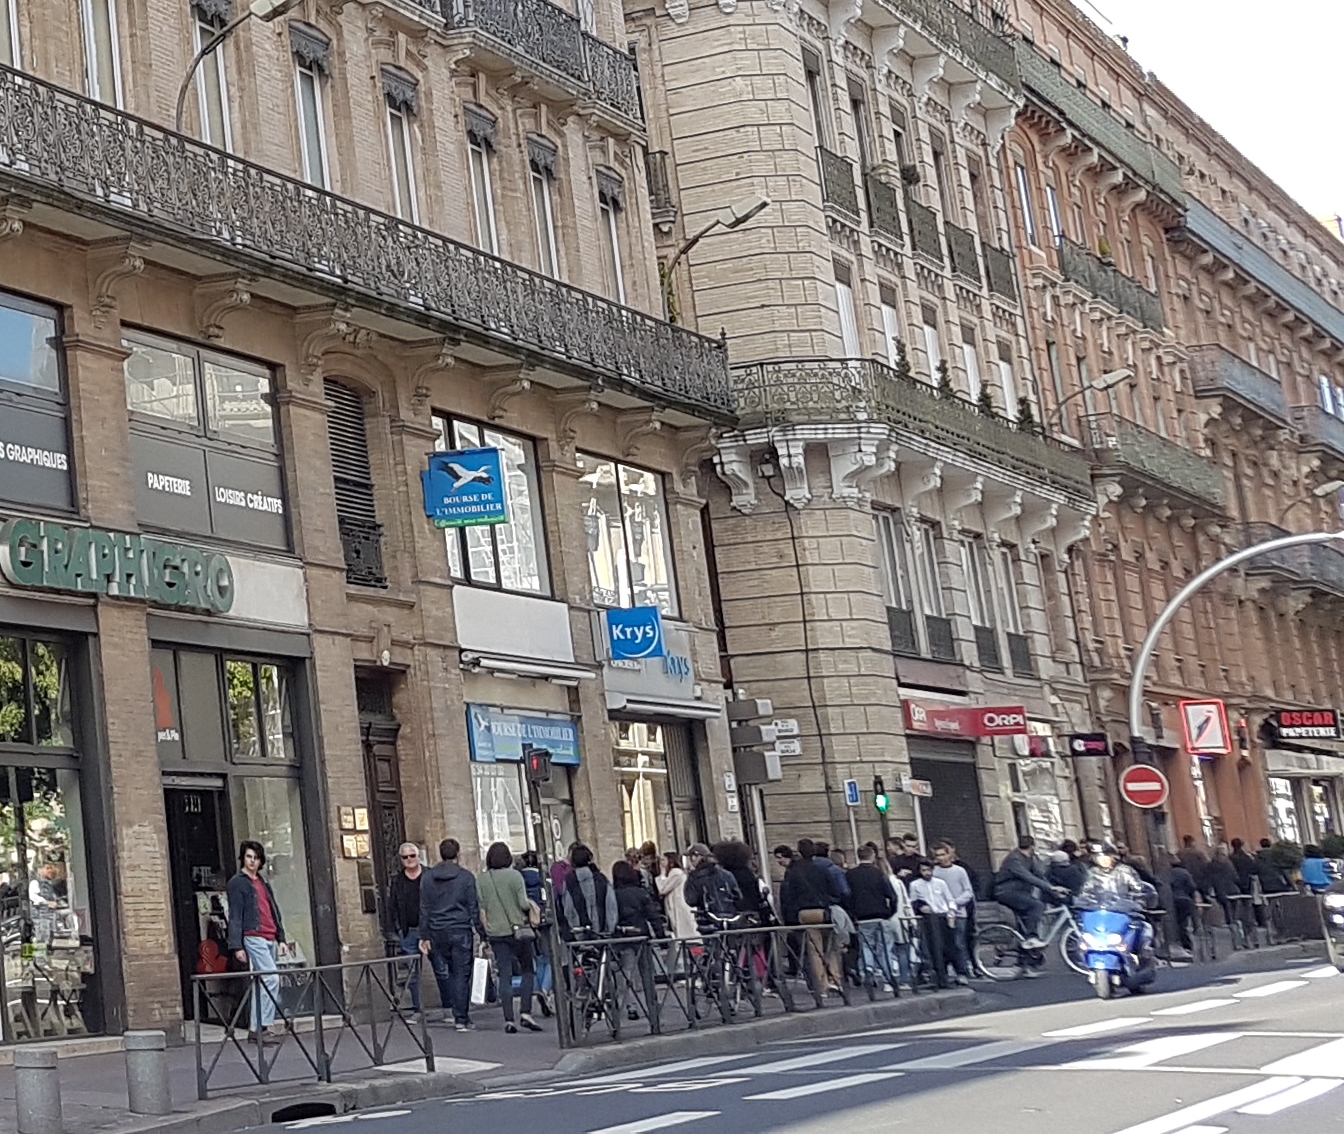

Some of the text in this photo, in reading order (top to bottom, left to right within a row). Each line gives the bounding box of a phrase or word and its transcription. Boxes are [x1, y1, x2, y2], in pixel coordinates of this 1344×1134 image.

[6, 443, 68, 471] GRAPHIQUES
[147, 472, 191, 496] PAPETERIE
[215, 486, 283, 514] LOISIRS CRÉATIFS
[443, 493, 494, 504] BOURSE DE
[436, 503, 502, 516] L'IMMOBILIER
[0, 518, 234, 614] GRAPHIGRO
[611, 624, 654, 643] Krys
[983, 713, 1024, 726] ORPI
[1280, 712, 1335, 726] OSCAR
